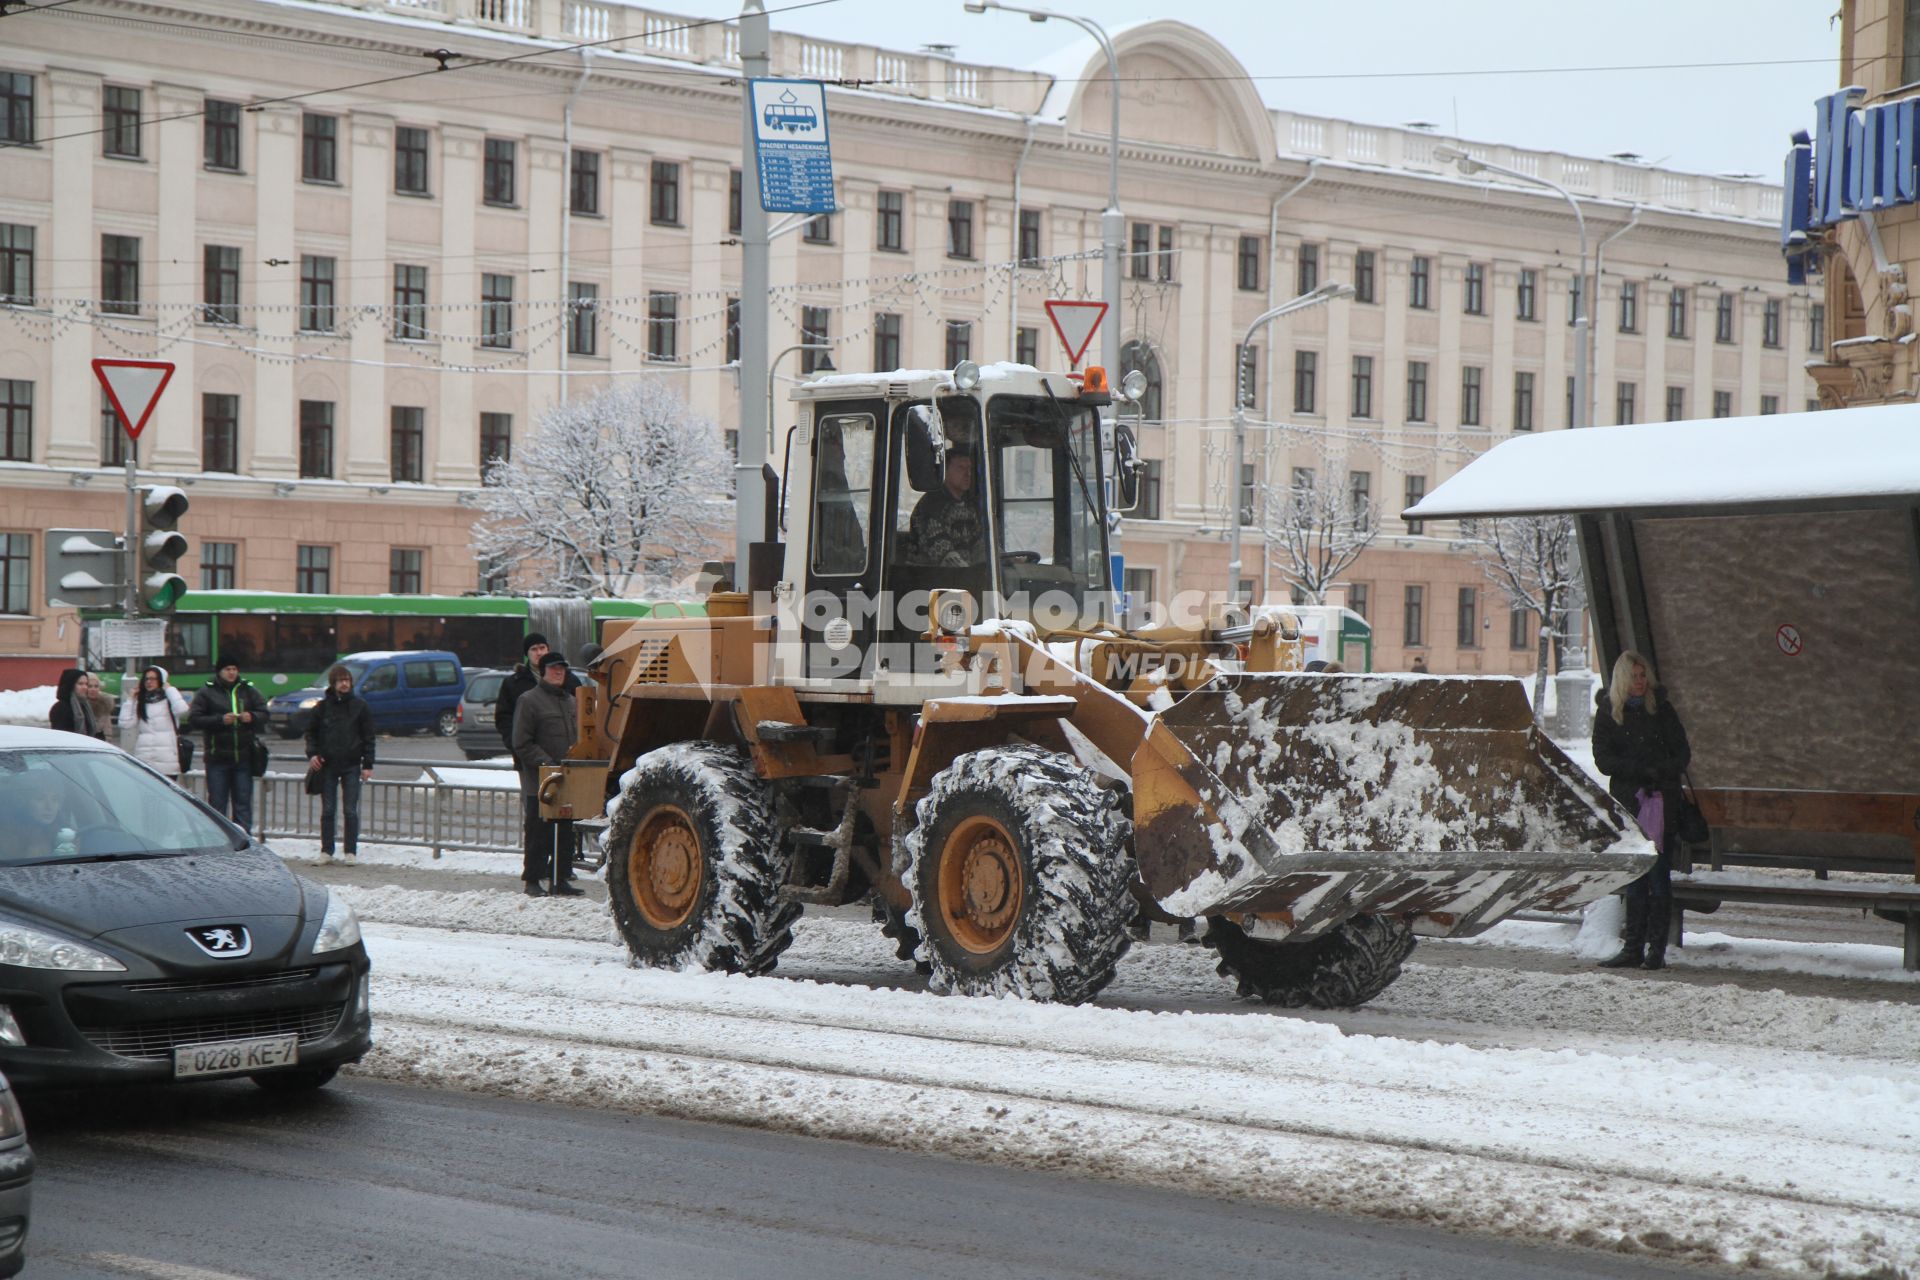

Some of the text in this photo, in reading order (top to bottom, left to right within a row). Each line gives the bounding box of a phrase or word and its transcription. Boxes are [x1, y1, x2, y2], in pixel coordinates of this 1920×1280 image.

[194, 1040, 294, 1072] 0228 KE-7
[177, 1064, 188, 1074] BY
